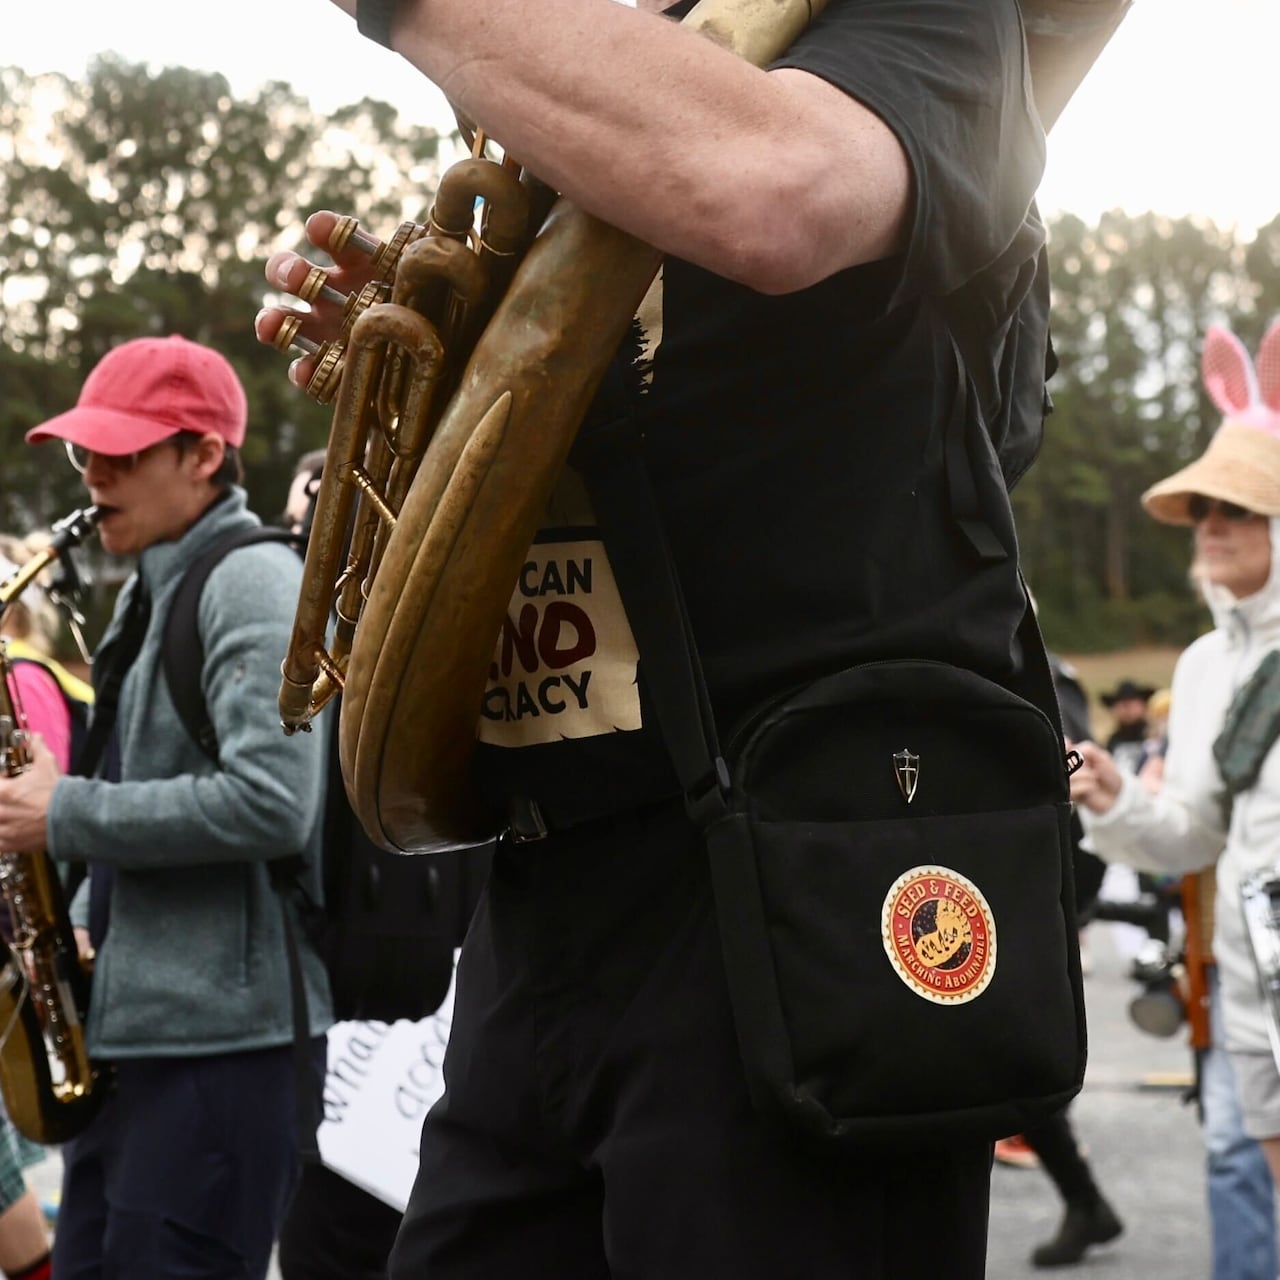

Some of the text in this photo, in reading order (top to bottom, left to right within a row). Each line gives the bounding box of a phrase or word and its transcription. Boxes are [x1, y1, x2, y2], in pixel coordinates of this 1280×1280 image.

[519, 558, 593, 598] CAN
[489, 600, 597, 682] ND
[897, 879, 978, 919] SEED & FEED
[897, 933, 942, 987] MARCHING
